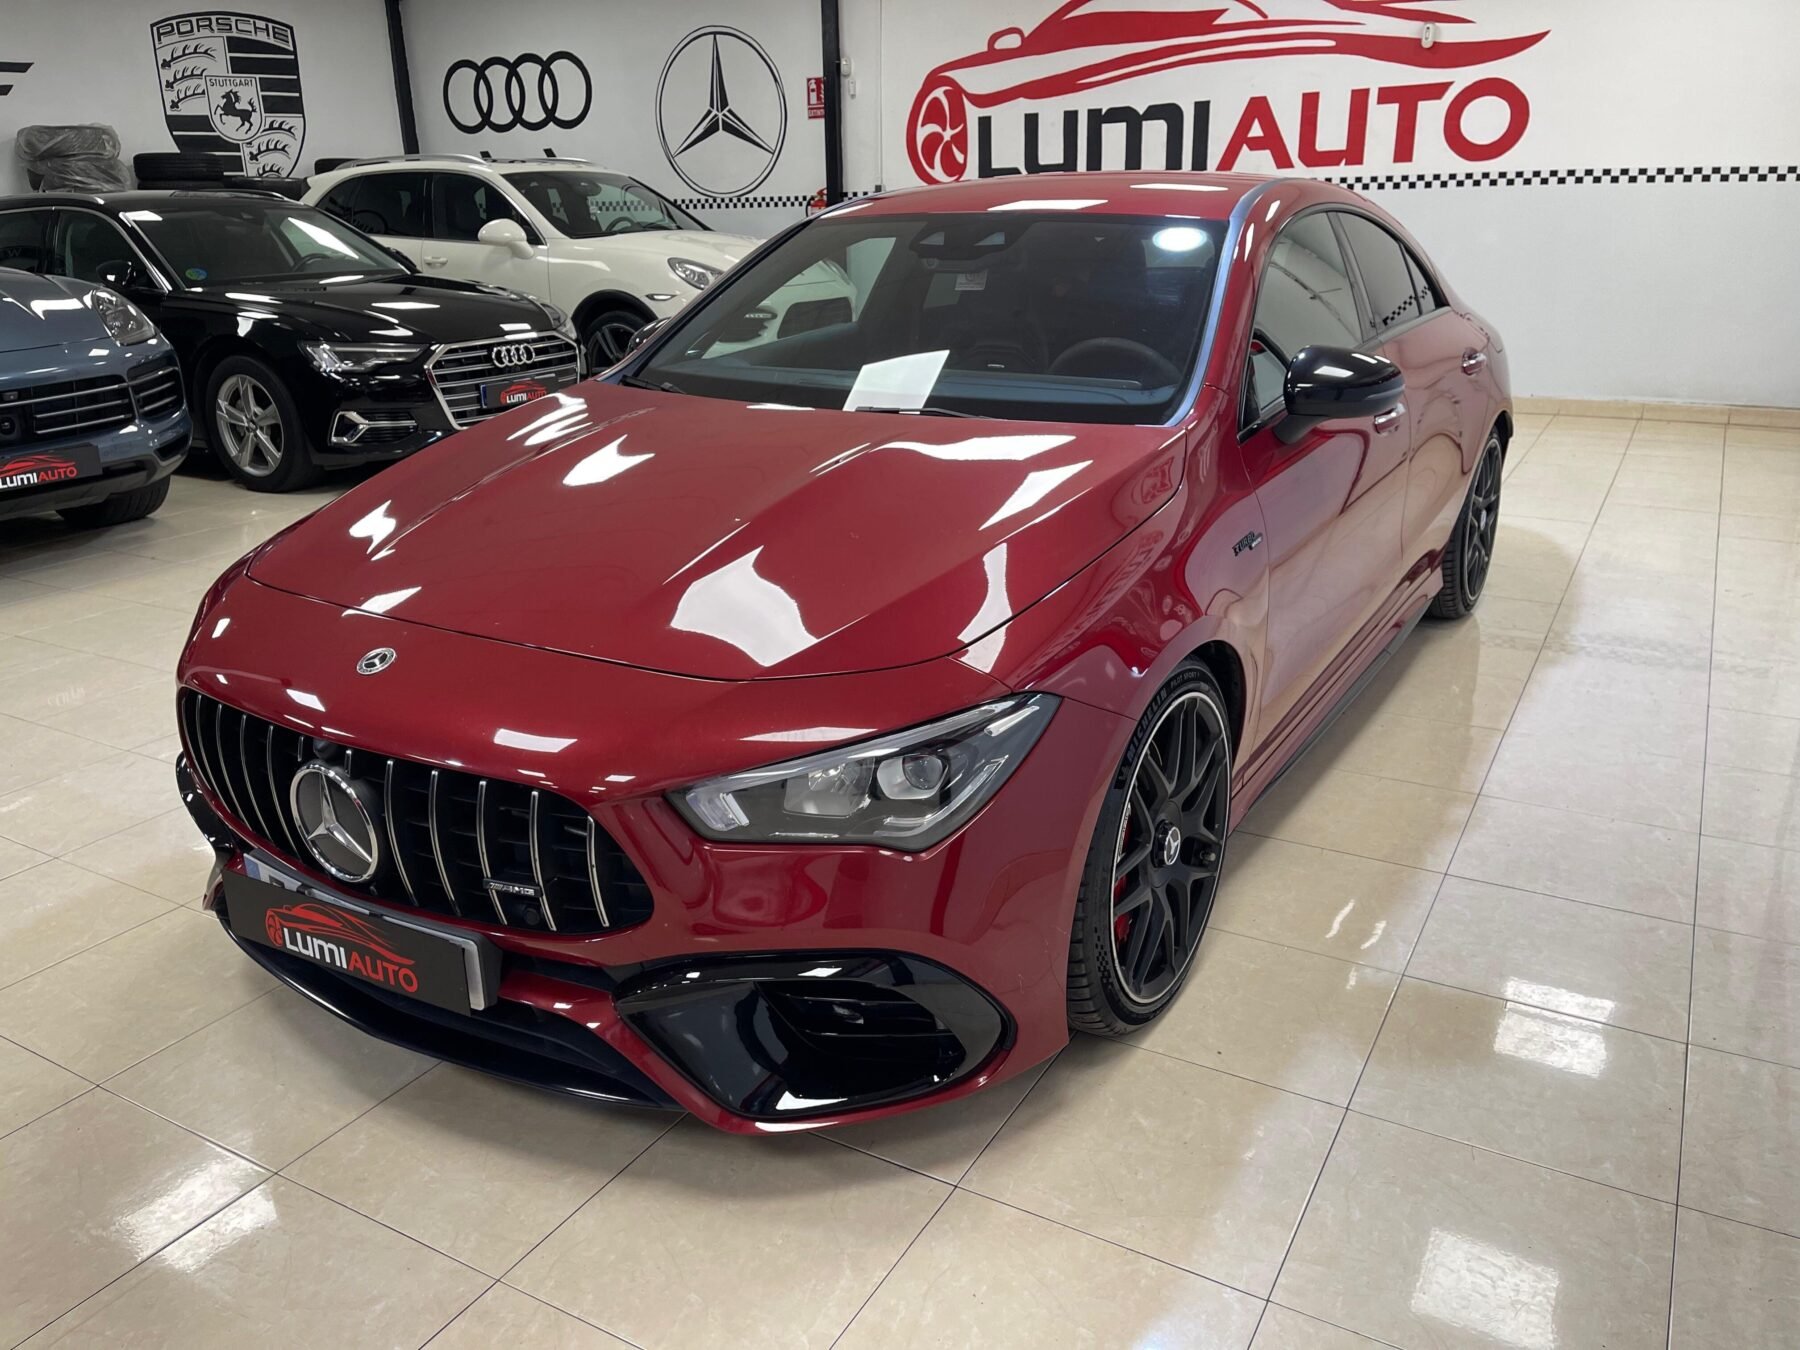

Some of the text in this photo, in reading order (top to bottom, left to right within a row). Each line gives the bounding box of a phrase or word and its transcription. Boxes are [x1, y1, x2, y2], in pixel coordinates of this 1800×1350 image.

[156, 17, 290, 46] PORSCHE
[209, 78, 253, 88] STUTTGART
[1127, 689, 1168, 762] MICHELIN
